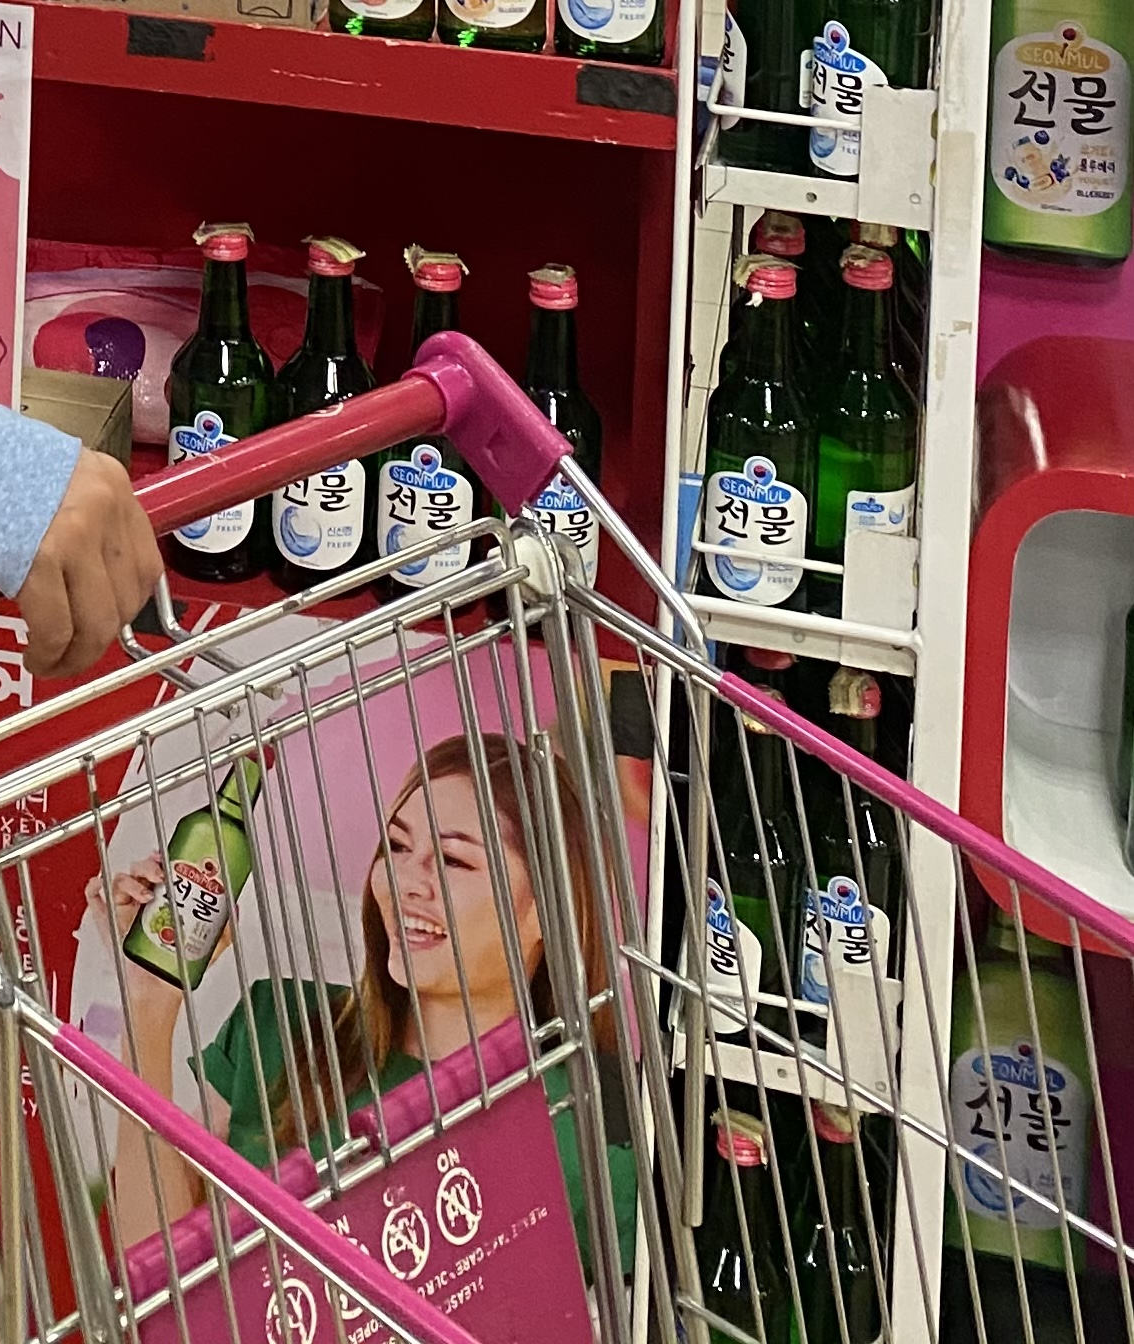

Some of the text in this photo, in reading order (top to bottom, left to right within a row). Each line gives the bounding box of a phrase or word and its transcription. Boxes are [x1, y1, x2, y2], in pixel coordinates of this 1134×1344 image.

[1021, 48, 1104, 70] SEONMUL
[1008, 70, 1116, 135] 선물
[392, 466, 452, 489] SEONMUL
[722, 477, 786, 503] SEONMUL
[386, 483, 461, 531] 선물
[537, 493, 585, 510] EONMU
[715, 495, 795, 546] 선물
[964, 1080, 1072, 1153] 선물
